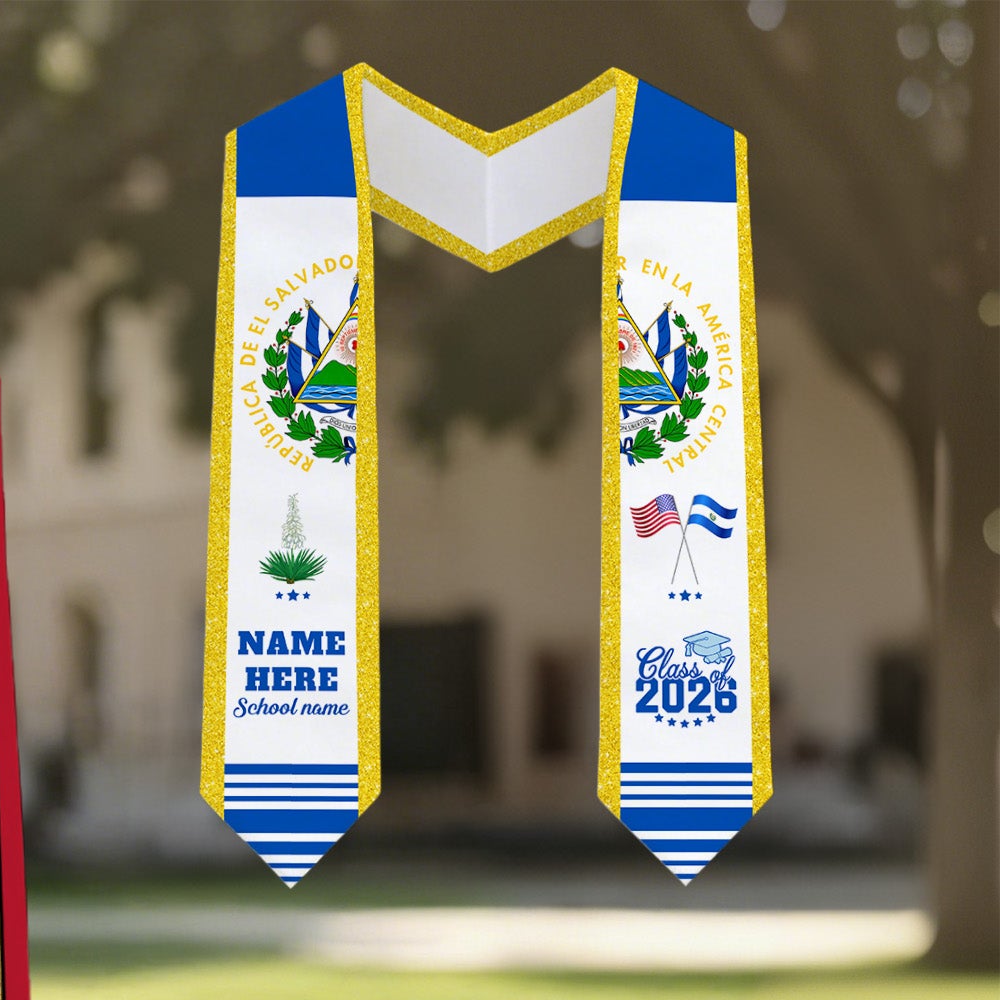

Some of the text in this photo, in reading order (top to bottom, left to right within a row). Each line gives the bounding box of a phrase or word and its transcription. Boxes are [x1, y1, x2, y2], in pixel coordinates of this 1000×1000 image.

[641, 258, 668, 280] EN
[671, 273, 693, 298] LA
[248, 316, 270, 336] EL
[240, 342, 258, 366] DE
[697, 303, 733, 390] AMÉRICA
[241, 380, 314, 472] REPÚBLICA
[662, 404, 726, 473] CENTRAL
[238, 630, 346, 656] NAME
[245, 667, 338, 691] HERE
[636, 646, 736, 690] Class of
[635, 676, 737, 713] 2026
[233, 697, 350, 718] School name
